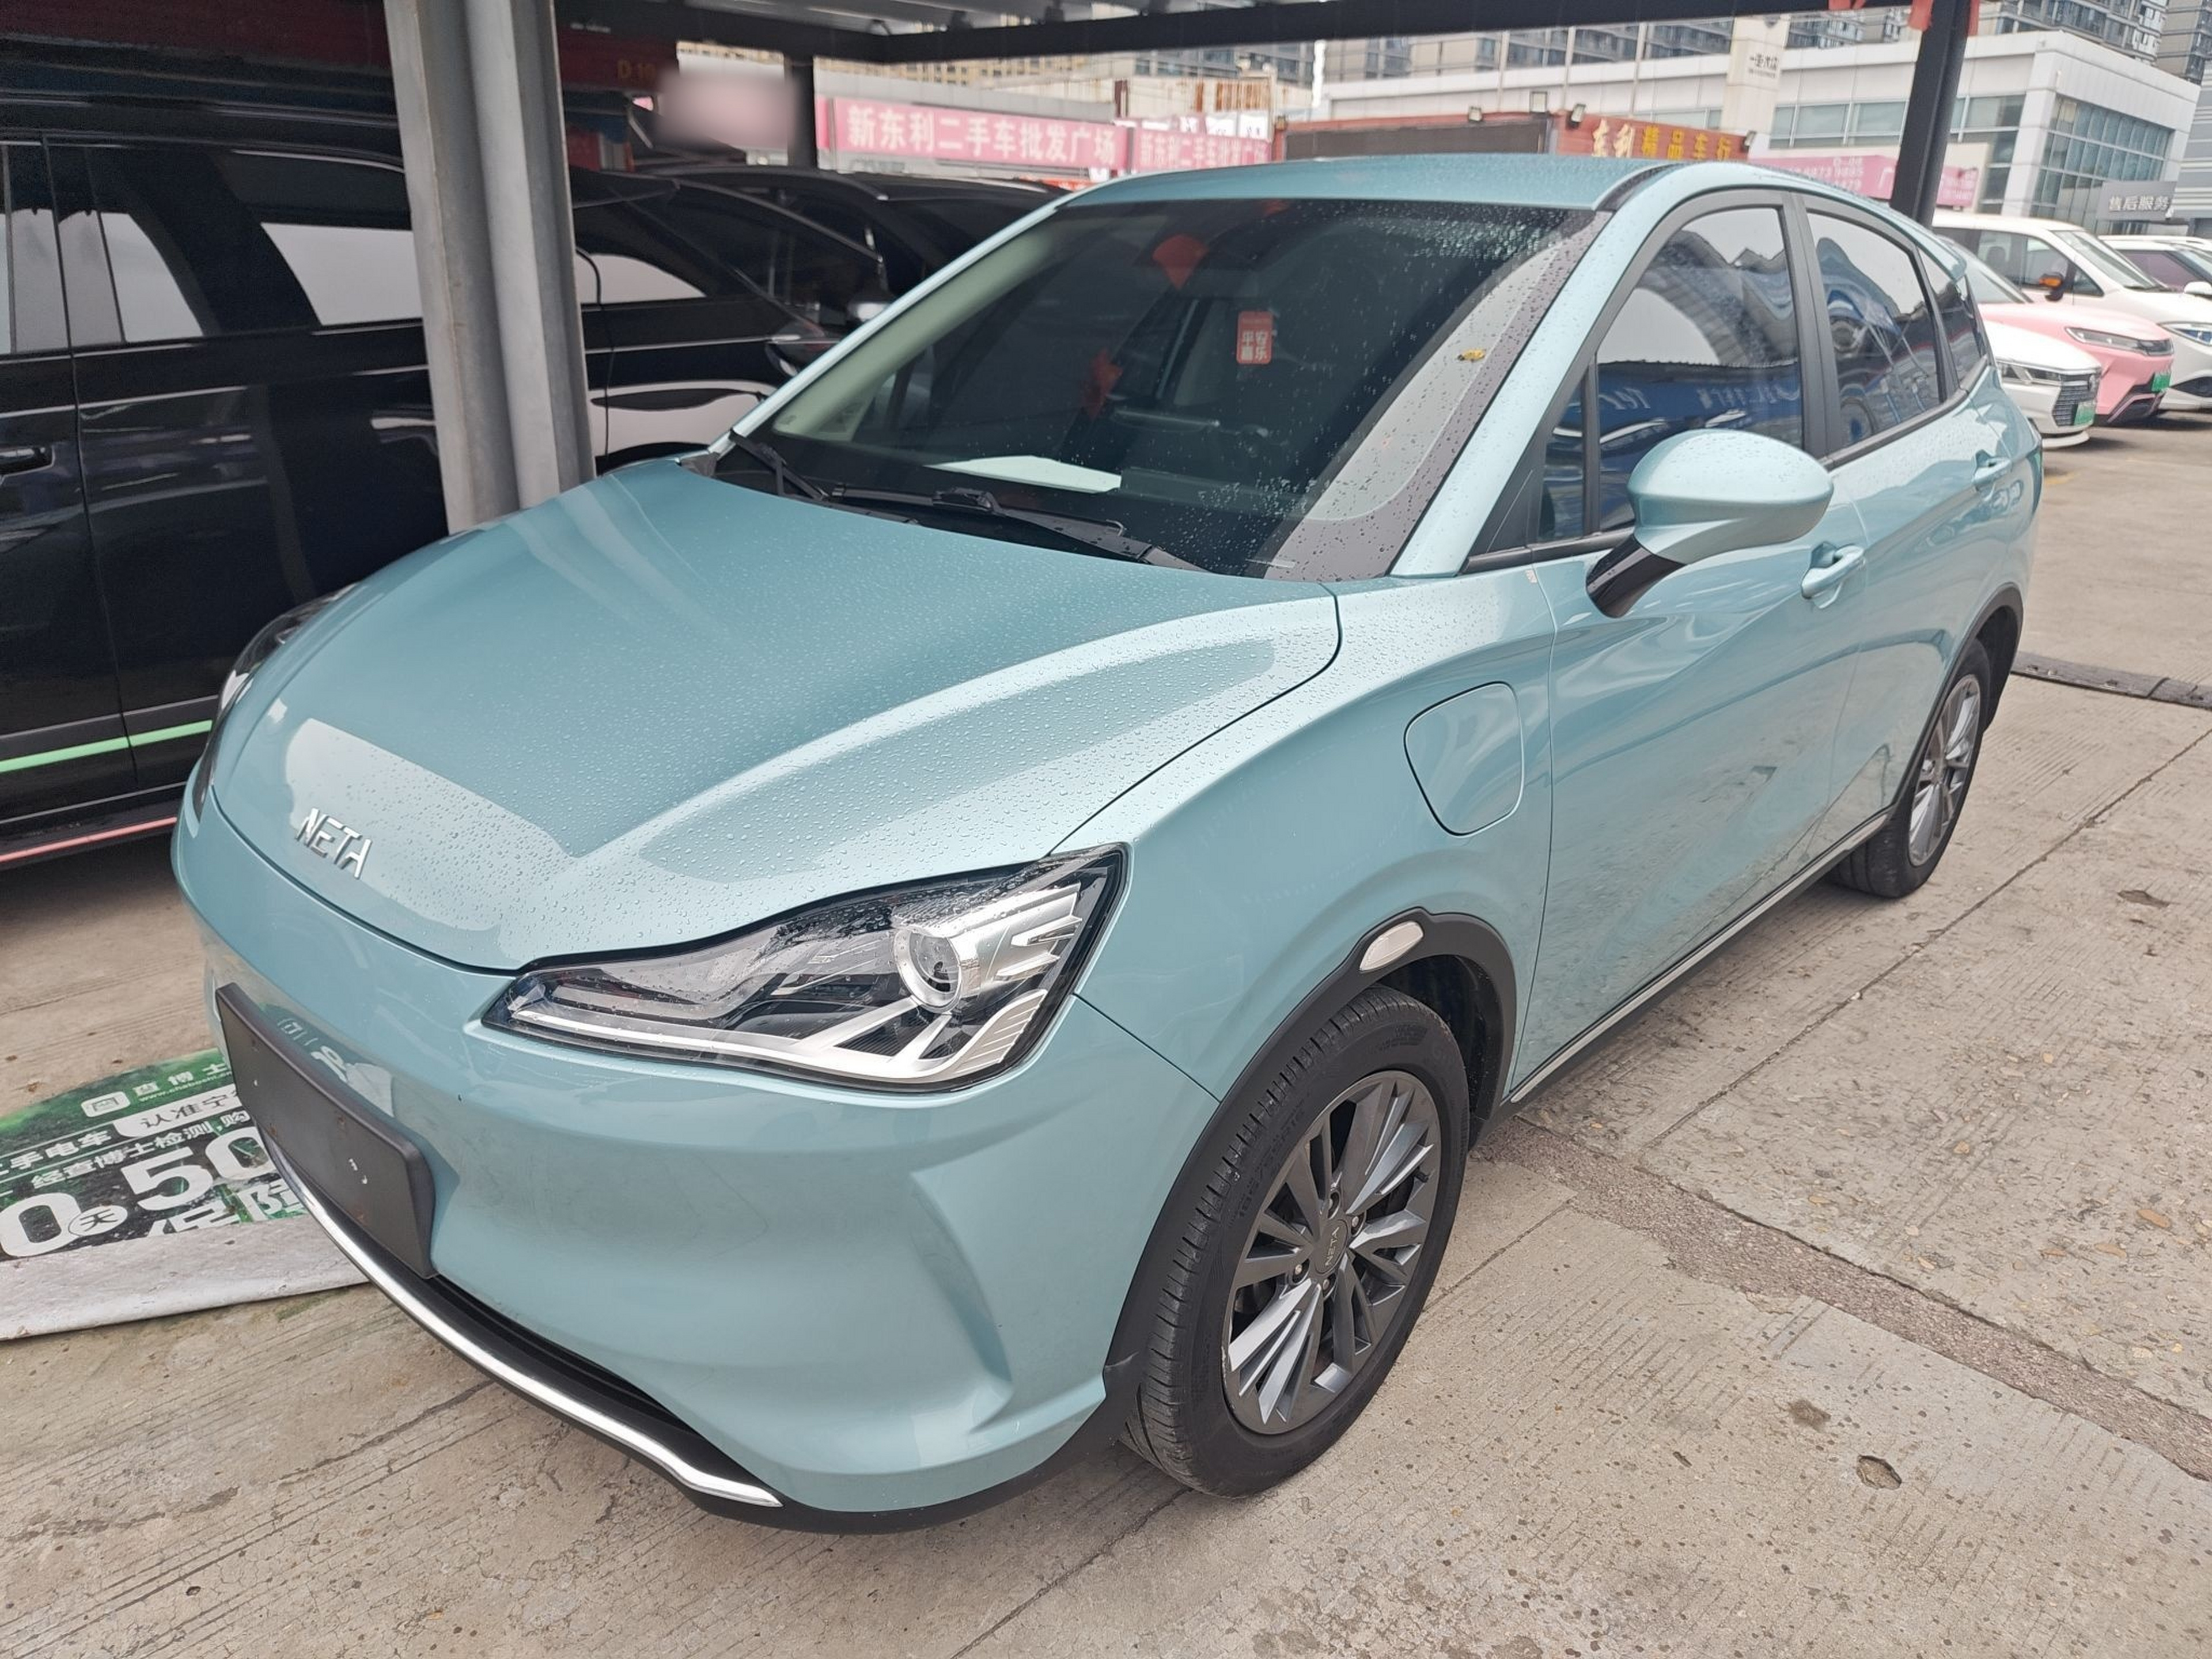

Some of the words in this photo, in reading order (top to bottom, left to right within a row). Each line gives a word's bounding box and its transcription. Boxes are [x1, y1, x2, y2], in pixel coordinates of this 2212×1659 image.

[847, 105, 1116, 165] 新东利二手车批发广场
[2109, 195, 2170, 211] 售后服务
[295, 808, 373, 880] NETA
[141, 1090, 236, 1128] 认准宁
[0, 1131, 112, 1176] 手电车
[1325, 1227, 1340, 1266] NETA
